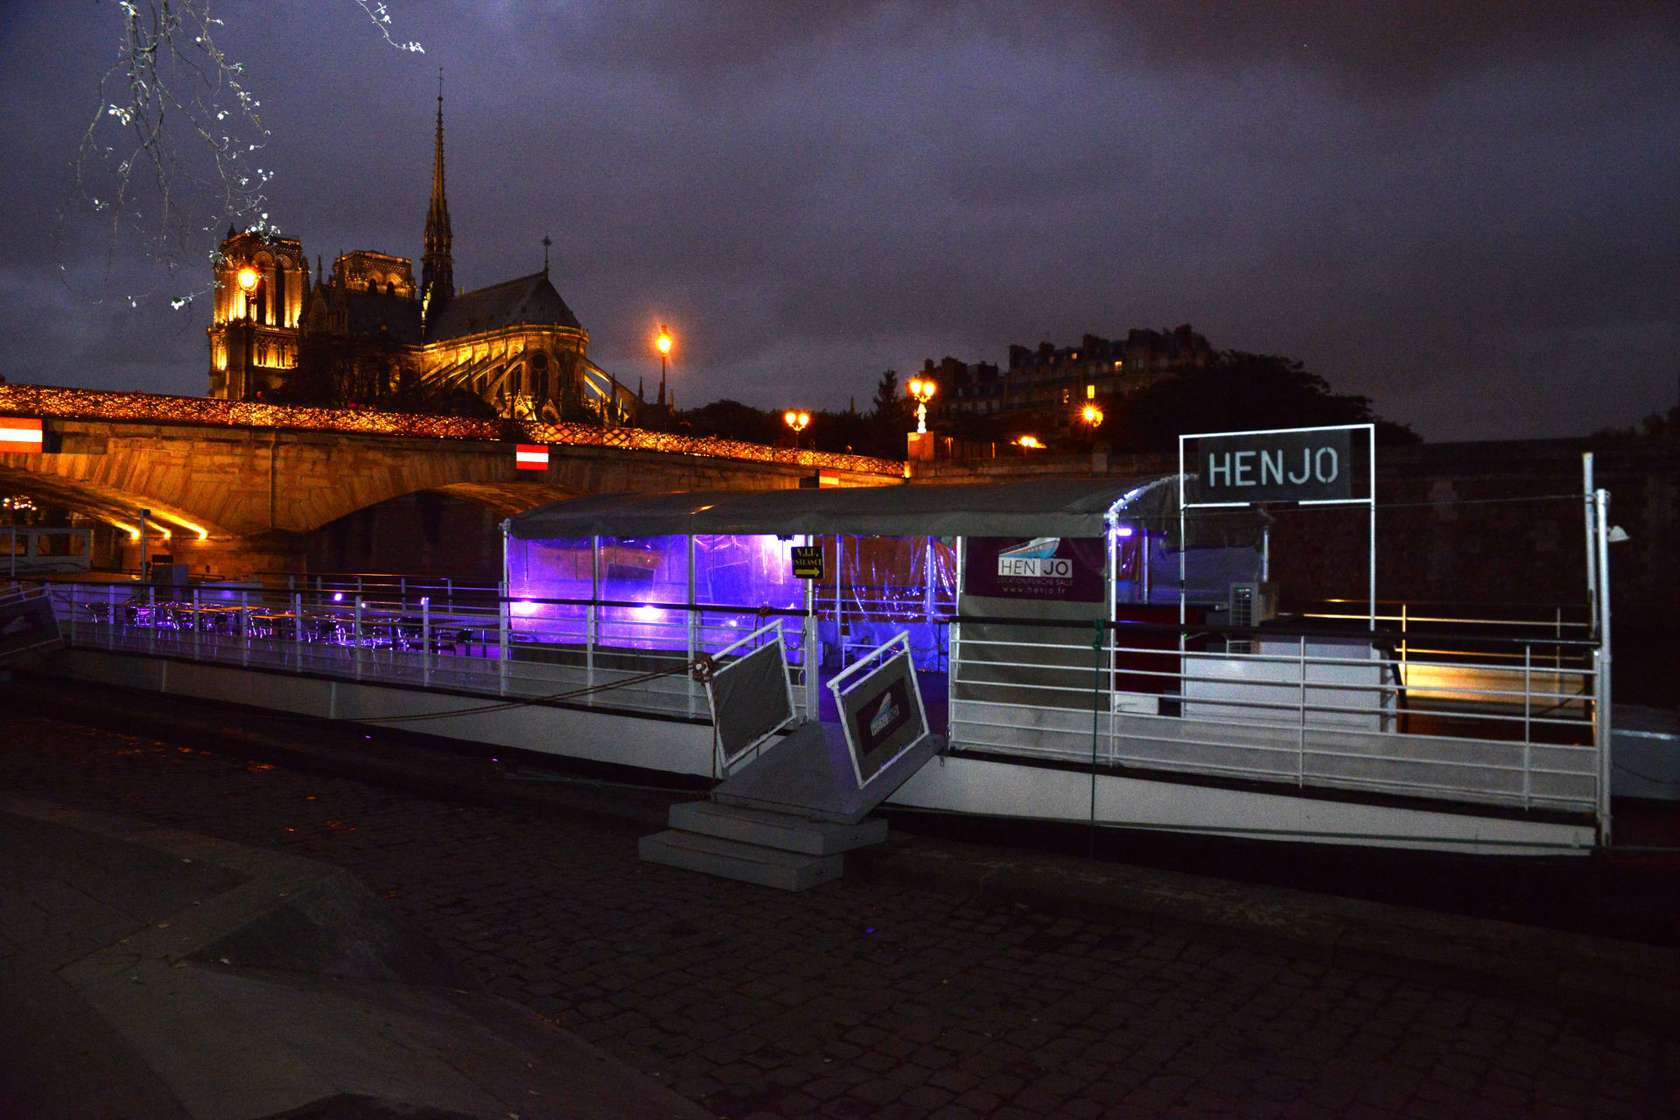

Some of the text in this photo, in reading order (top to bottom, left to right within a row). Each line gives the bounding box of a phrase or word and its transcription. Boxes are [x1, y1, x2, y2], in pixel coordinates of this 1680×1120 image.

[1208, 446, 1338, 487] HENJO
[1001, 559, 1069, 576] HEN JO
